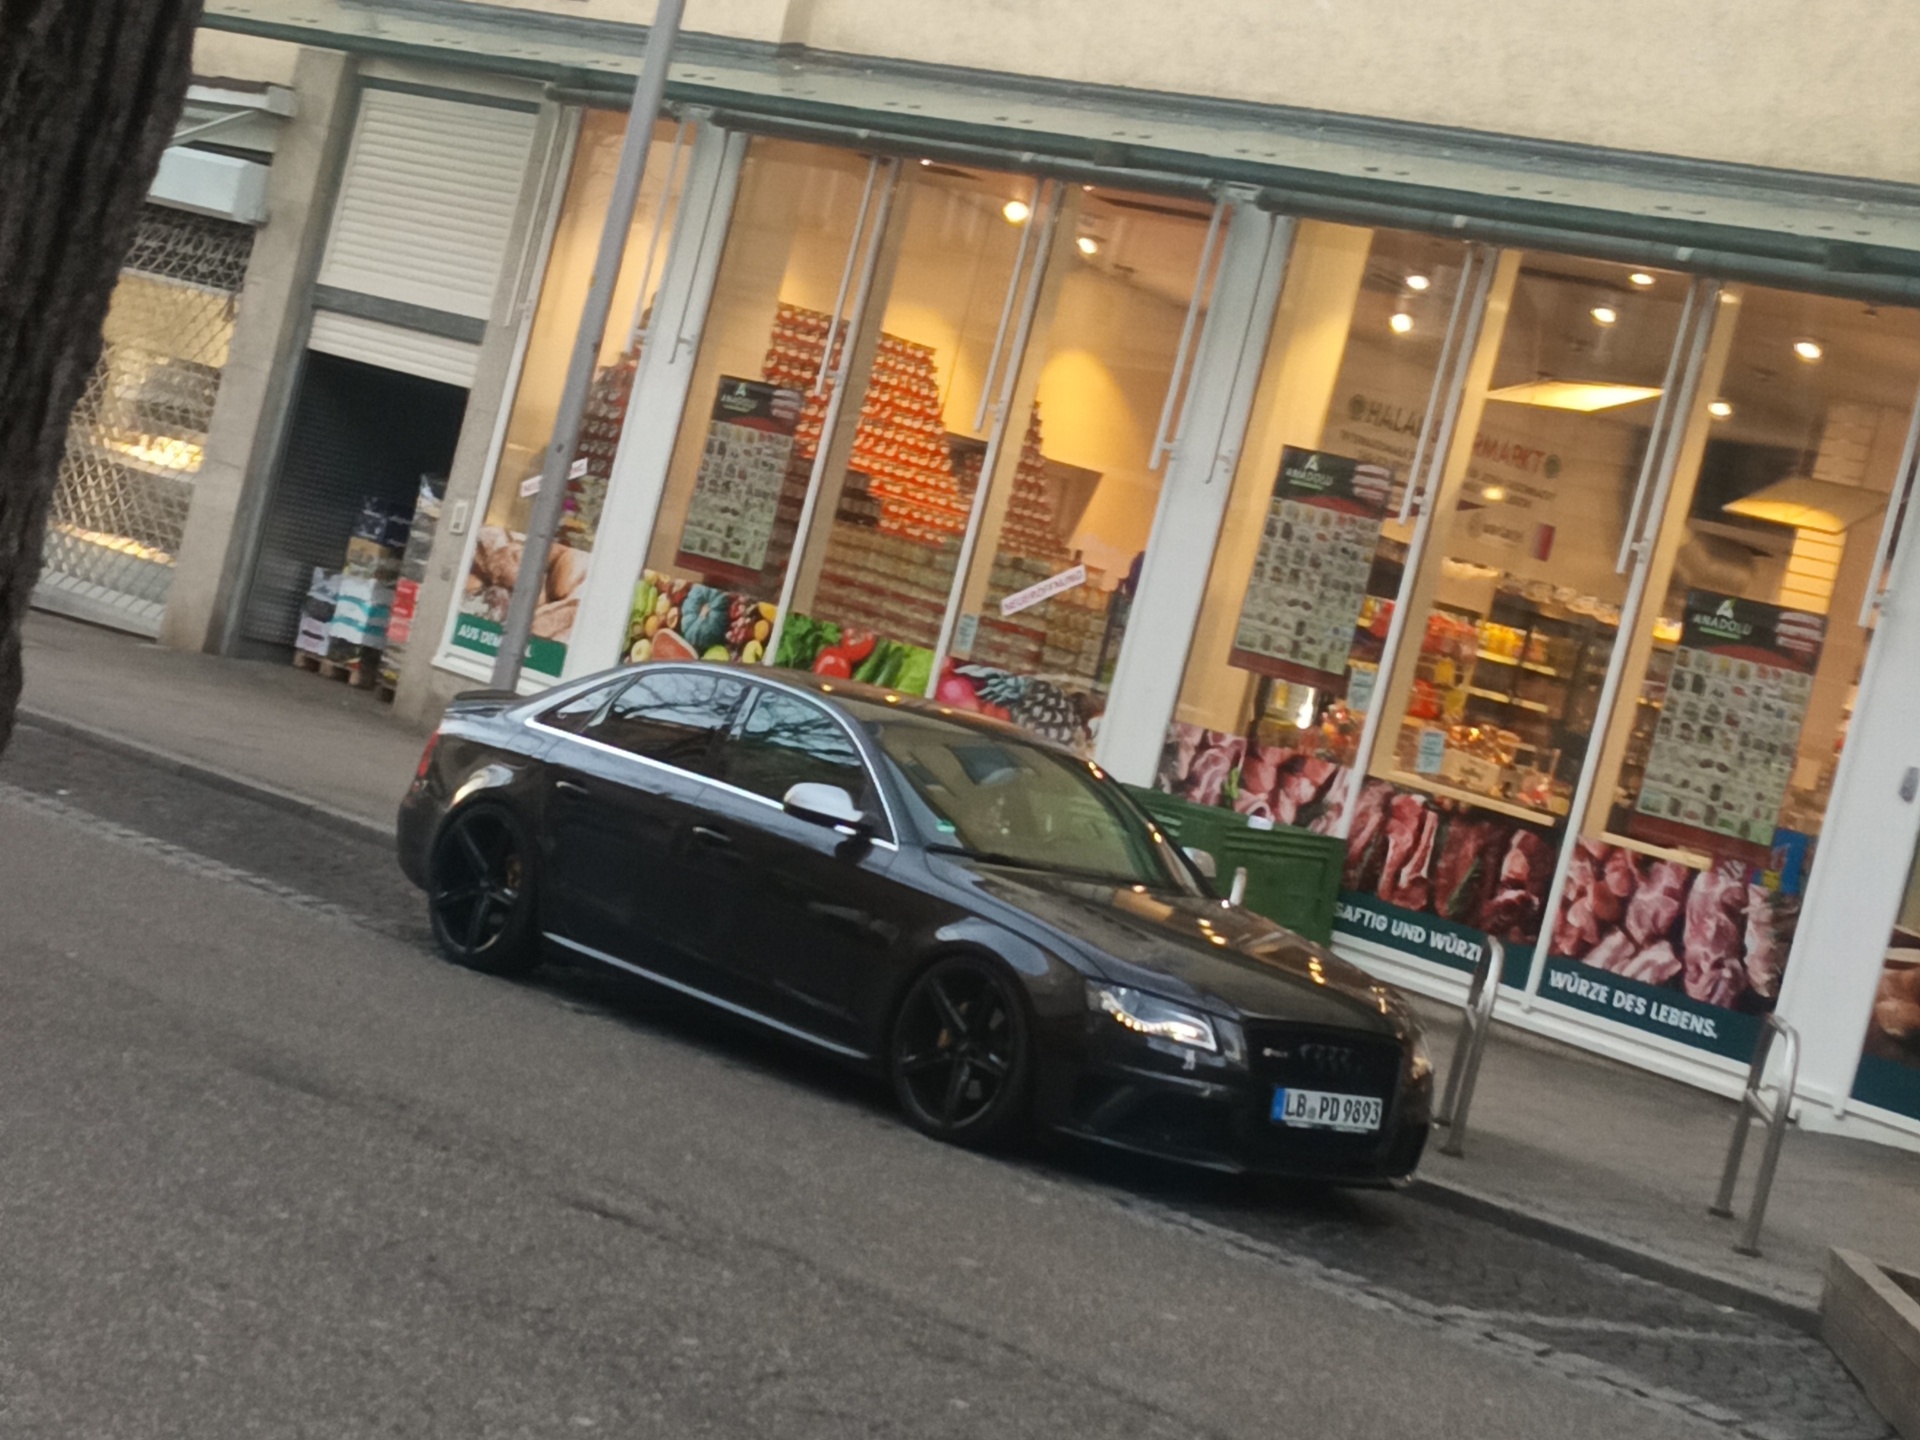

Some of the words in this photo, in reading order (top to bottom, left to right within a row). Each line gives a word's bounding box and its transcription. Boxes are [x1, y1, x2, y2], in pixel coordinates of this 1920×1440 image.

[1692, 613, 1753, 635] ANADOLU
[1391, 918, 1426, 944] UND
[1430, 930, 1483, 963] WÜRZI
[1549, 968, 1610, 1004] WÜRZE
[1612, 989, 1648, 1016] DES
[1285, 1092, 1308, 1119] LB
[1318, 1096, 1341, 1122] PD
[1343, 1099, 1381, 1126] 9893
